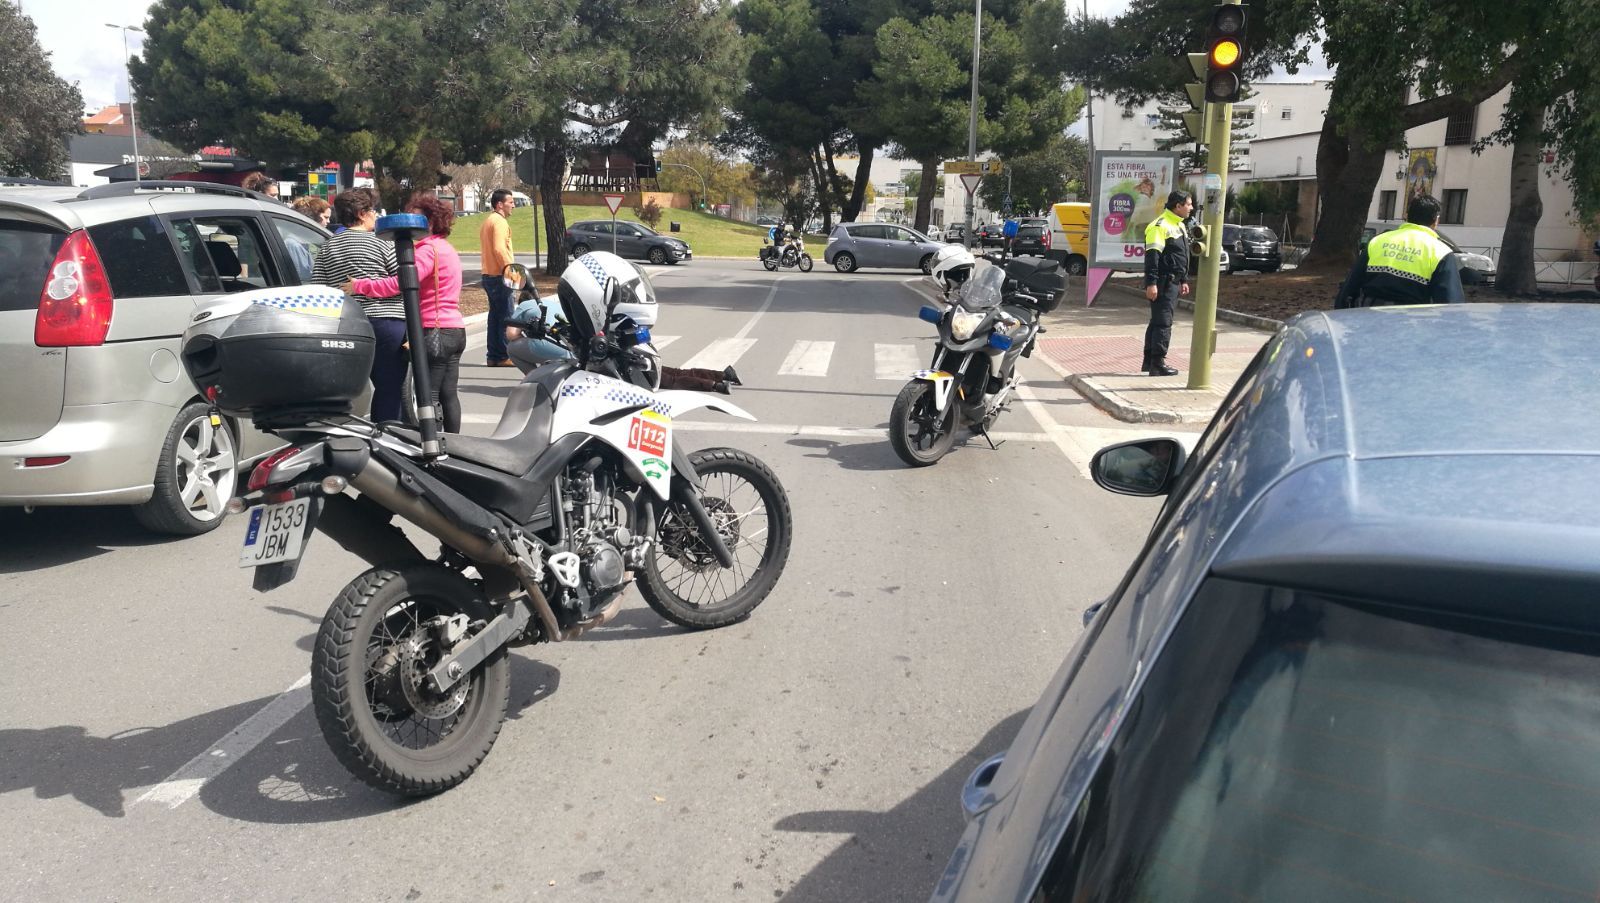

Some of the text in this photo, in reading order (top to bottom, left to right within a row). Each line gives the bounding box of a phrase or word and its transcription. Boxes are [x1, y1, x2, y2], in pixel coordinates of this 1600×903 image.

[1382, 242, 1421, 256] POLICIA
[1383, 250, 1415, 262] LOCAL
[643, 427, 665, 444] 112
[265, 503, 305, 533] 1533
[255, 531, 290, 560] JBM
